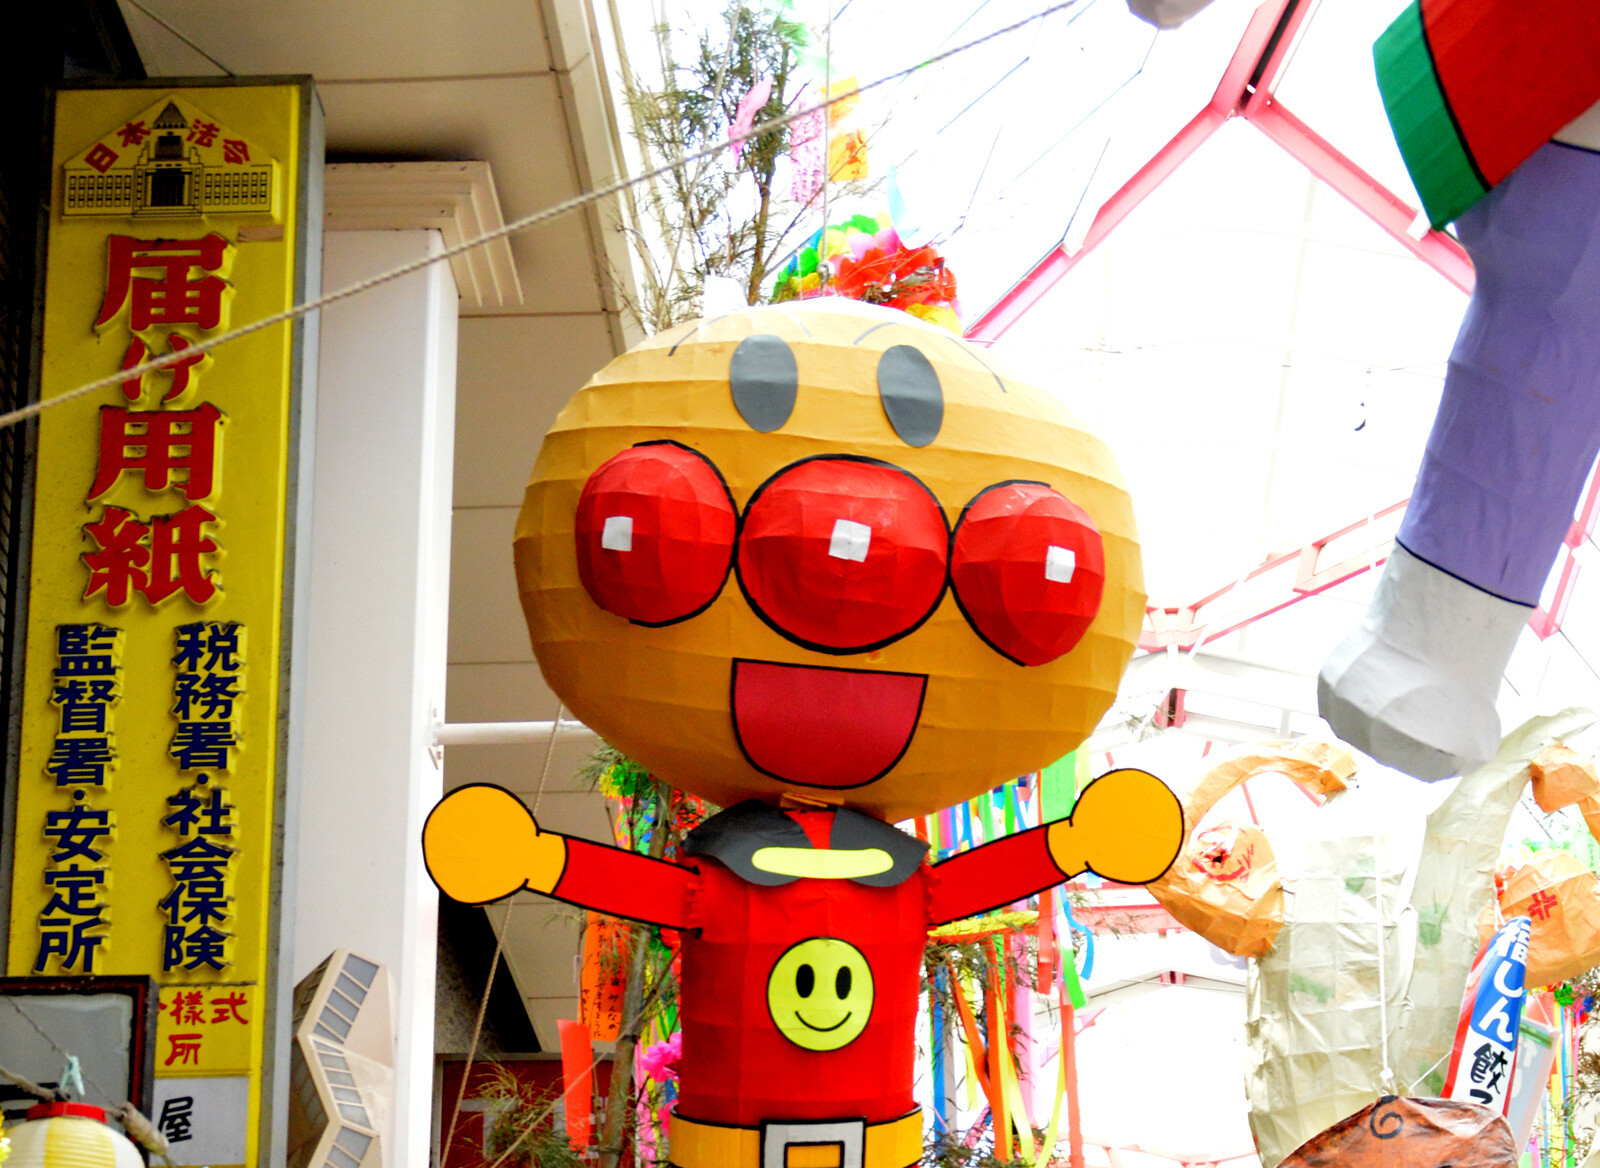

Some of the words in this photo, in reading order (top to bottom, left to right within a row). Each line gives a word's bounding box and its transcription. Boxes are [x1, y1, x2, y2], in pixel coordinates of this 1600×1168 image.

[83, 233, 227, 607] 届け用紙
[35, 624, 117, 973] 監督署・安定所
[160, 622, 240, 973] 税務署・社会保険
